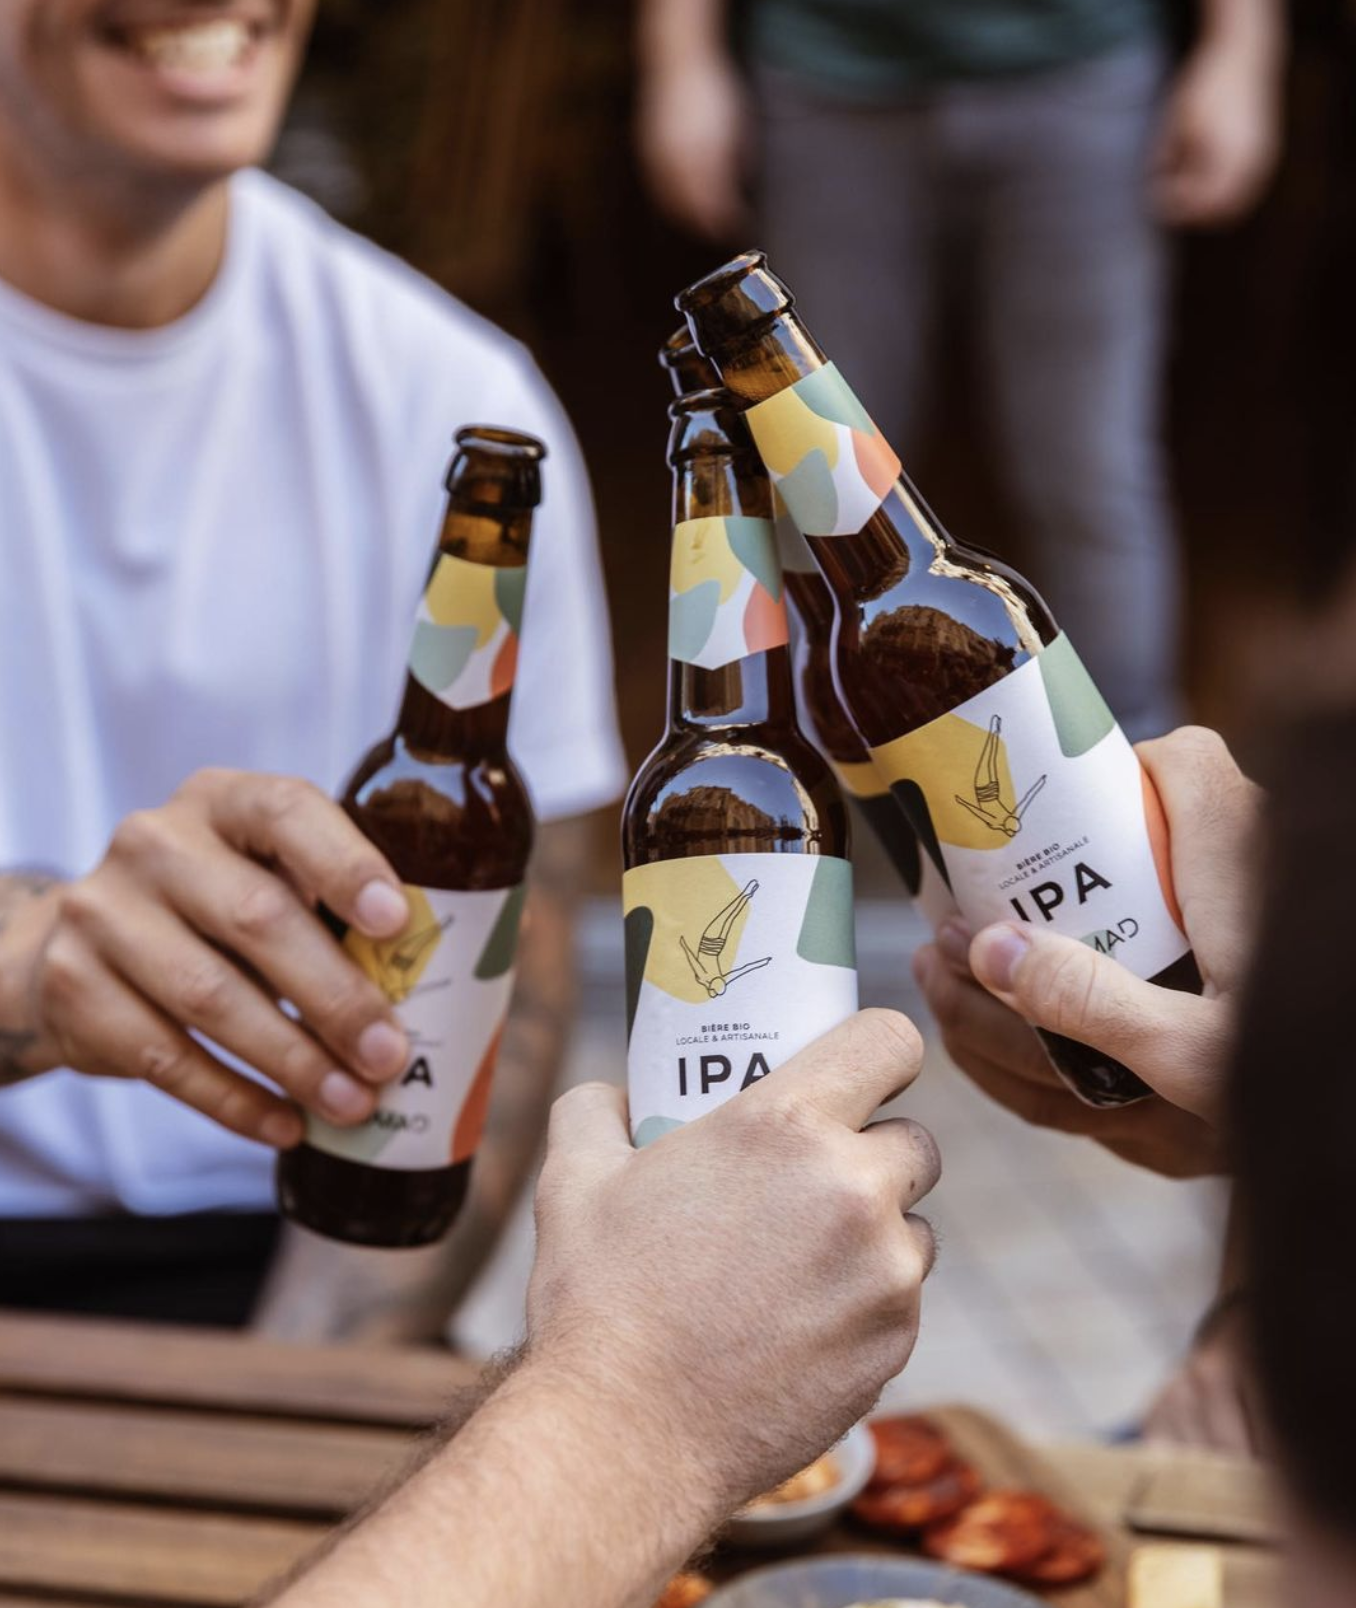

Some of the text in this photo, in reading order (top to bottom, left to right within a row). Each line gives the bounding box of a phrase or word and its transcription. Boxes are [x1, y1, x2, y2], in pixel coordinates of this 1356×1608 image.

[998, 836, 1090, 890] LOCALE & ARTISANALE
[1044, 843, 1061, 856] BIO
[1010, 862, 1113, 922] IPA
[675, 1035, 709, 1045] LOCALE
[721, 1031, 780, 1042] ARTISANALE
[701, 1022, 751, 1033] BIÈRE BIO
[678, 1052, 771, 1096] IPA
